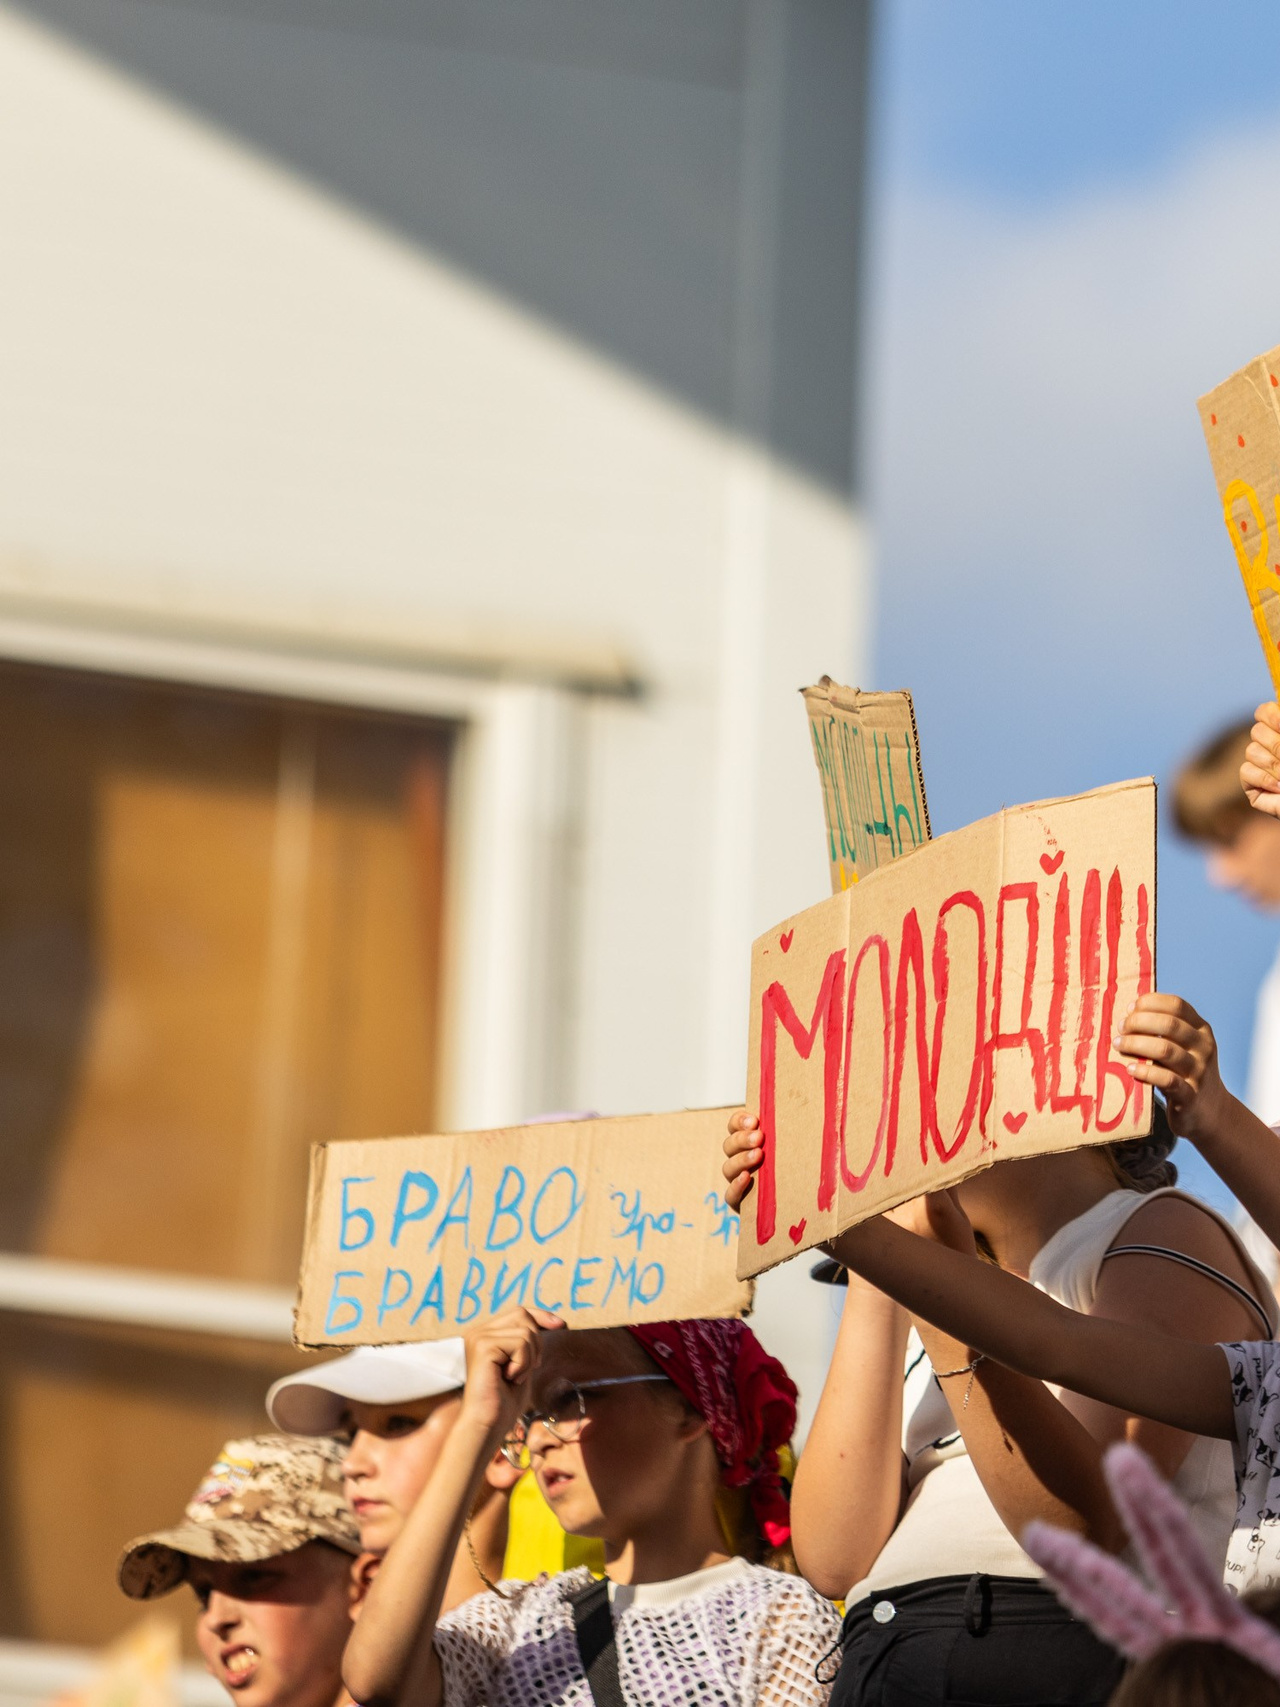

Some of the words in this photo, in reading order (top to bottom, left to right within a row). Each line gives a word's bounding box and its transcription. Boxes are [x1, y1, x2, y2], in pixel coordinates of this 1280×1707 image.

[757, 864, 1152, 1245] МОЛОДЦЫ
[339, 1164, 586, 1252] БРАВО
[324, 1254, 665, 1336] БРАВИСЕМО
